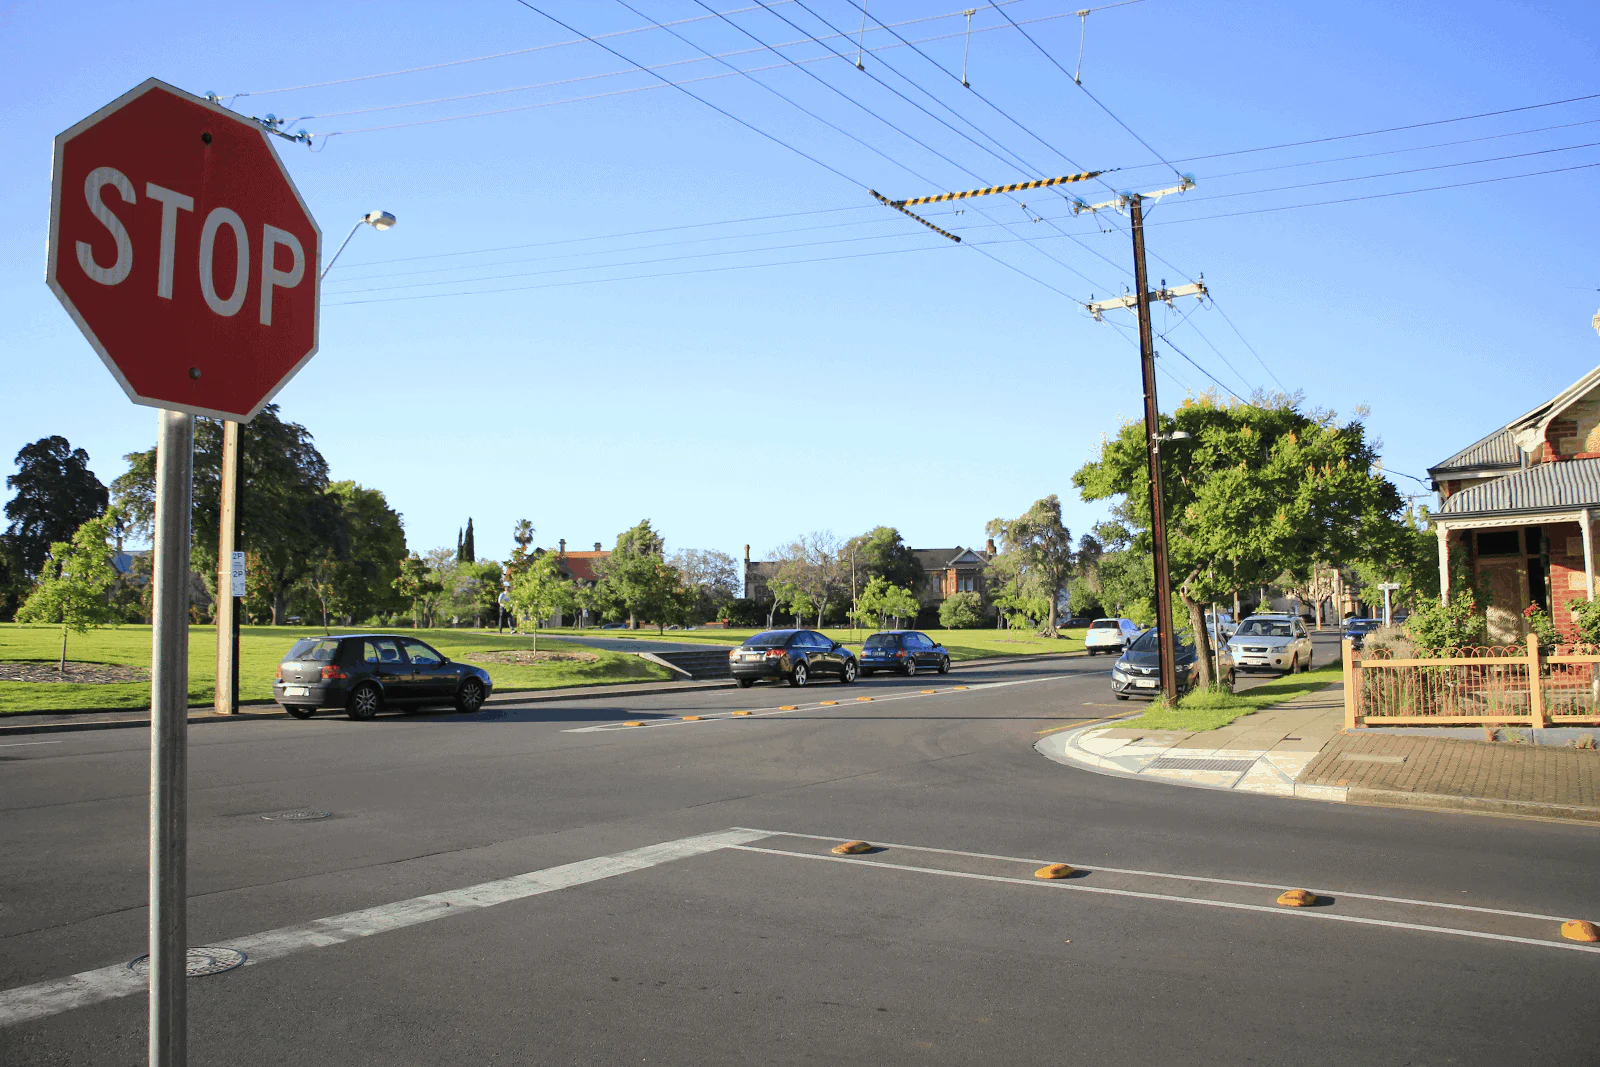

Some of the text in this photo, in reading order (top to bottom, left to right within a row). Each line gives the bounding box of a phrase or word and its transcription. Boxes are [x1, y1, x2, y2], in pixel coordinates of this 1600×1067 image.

[75, 166, 305, 326] STOP
[232, 552, 243, 560] 2P
[232, 570, 244, 578] 2P
